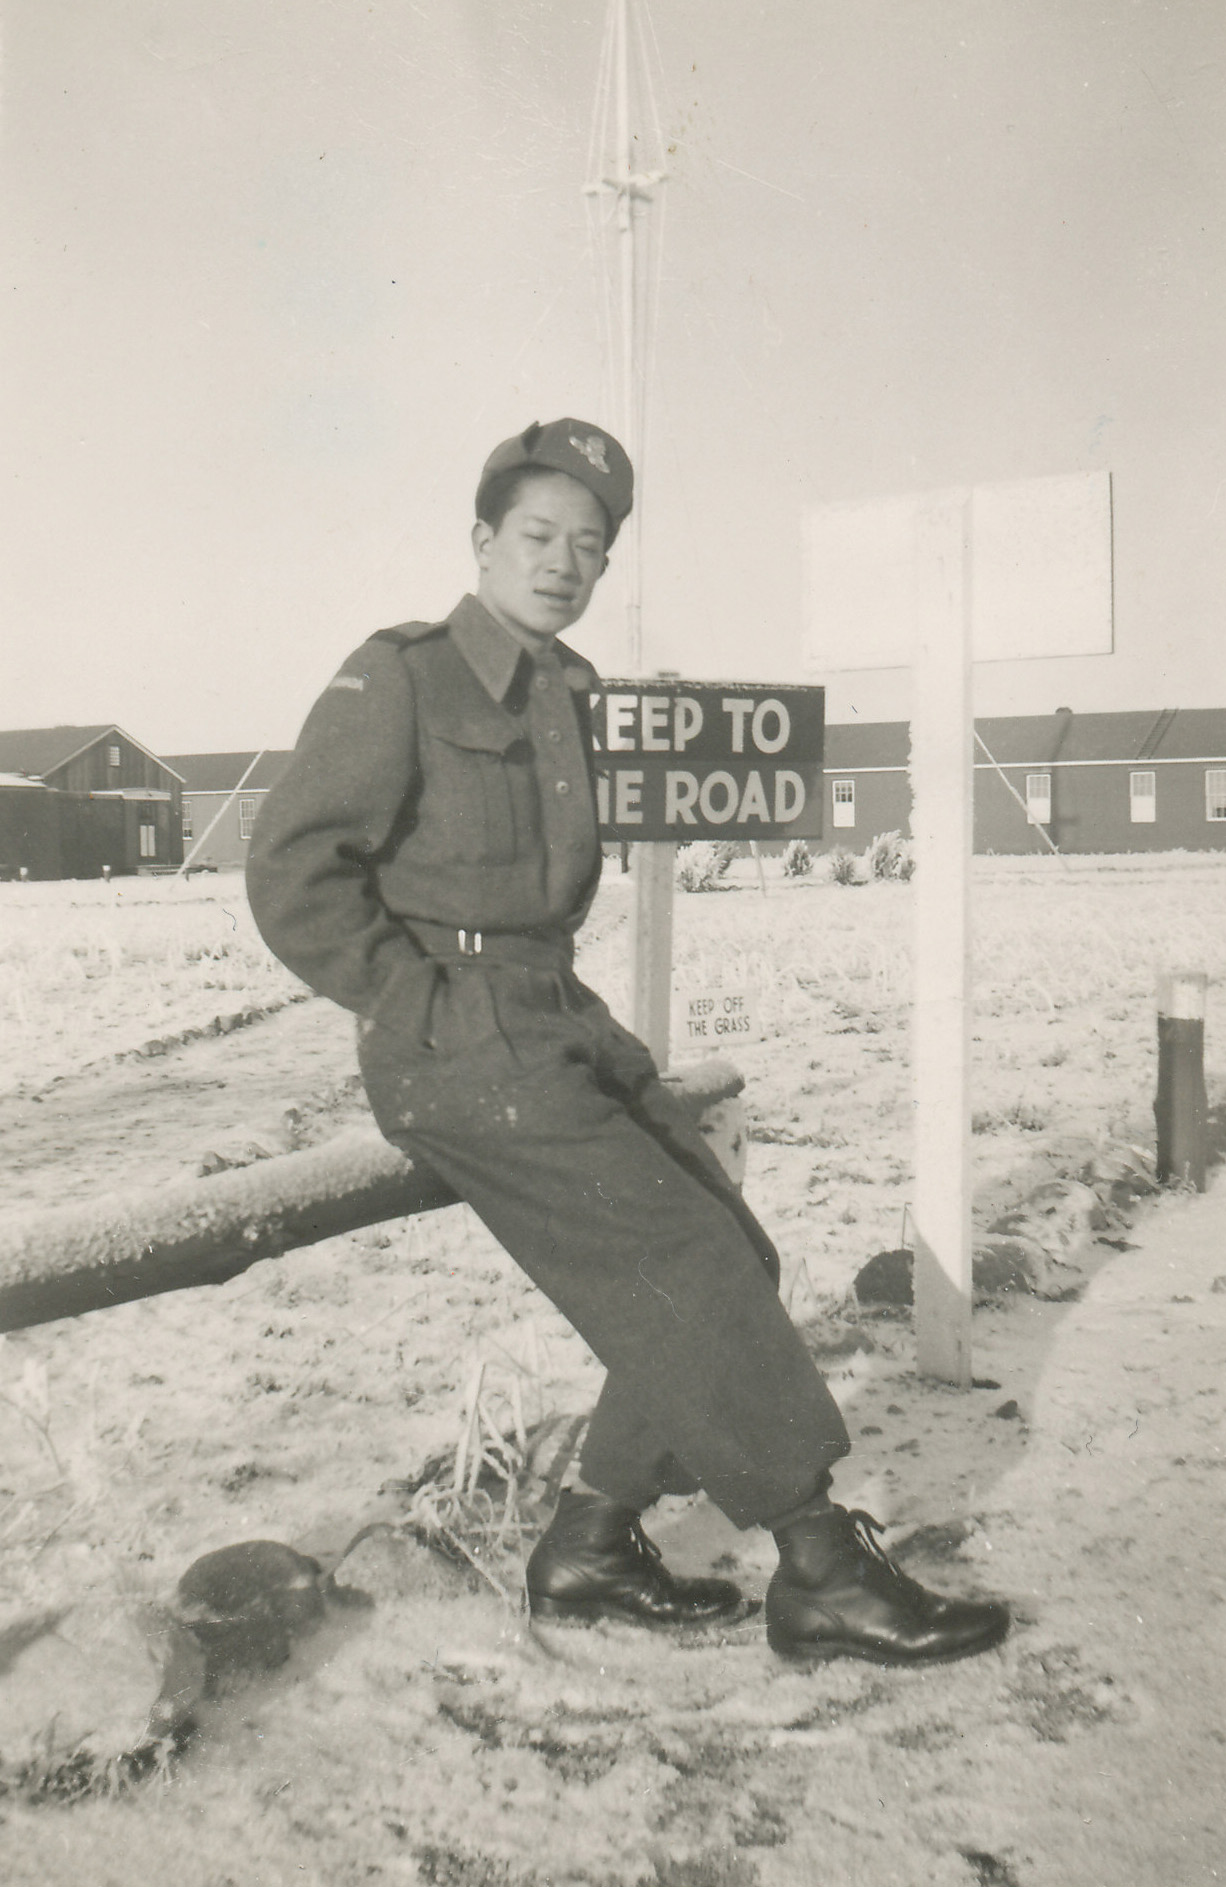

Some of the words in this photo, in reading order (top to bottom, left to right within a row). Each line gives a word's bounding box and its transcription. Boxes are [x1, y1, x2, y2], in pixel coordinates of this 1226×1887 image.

[722, 698, 791, 754] TO
[665, 770, 806, 825] ROAD
[688, 998, 715, 1016] KEEP
[723, 996, 744, 1014] OFF
[687, 1020, 708, 1037] THE
[714, 1015, 750, 1035] GRASS
